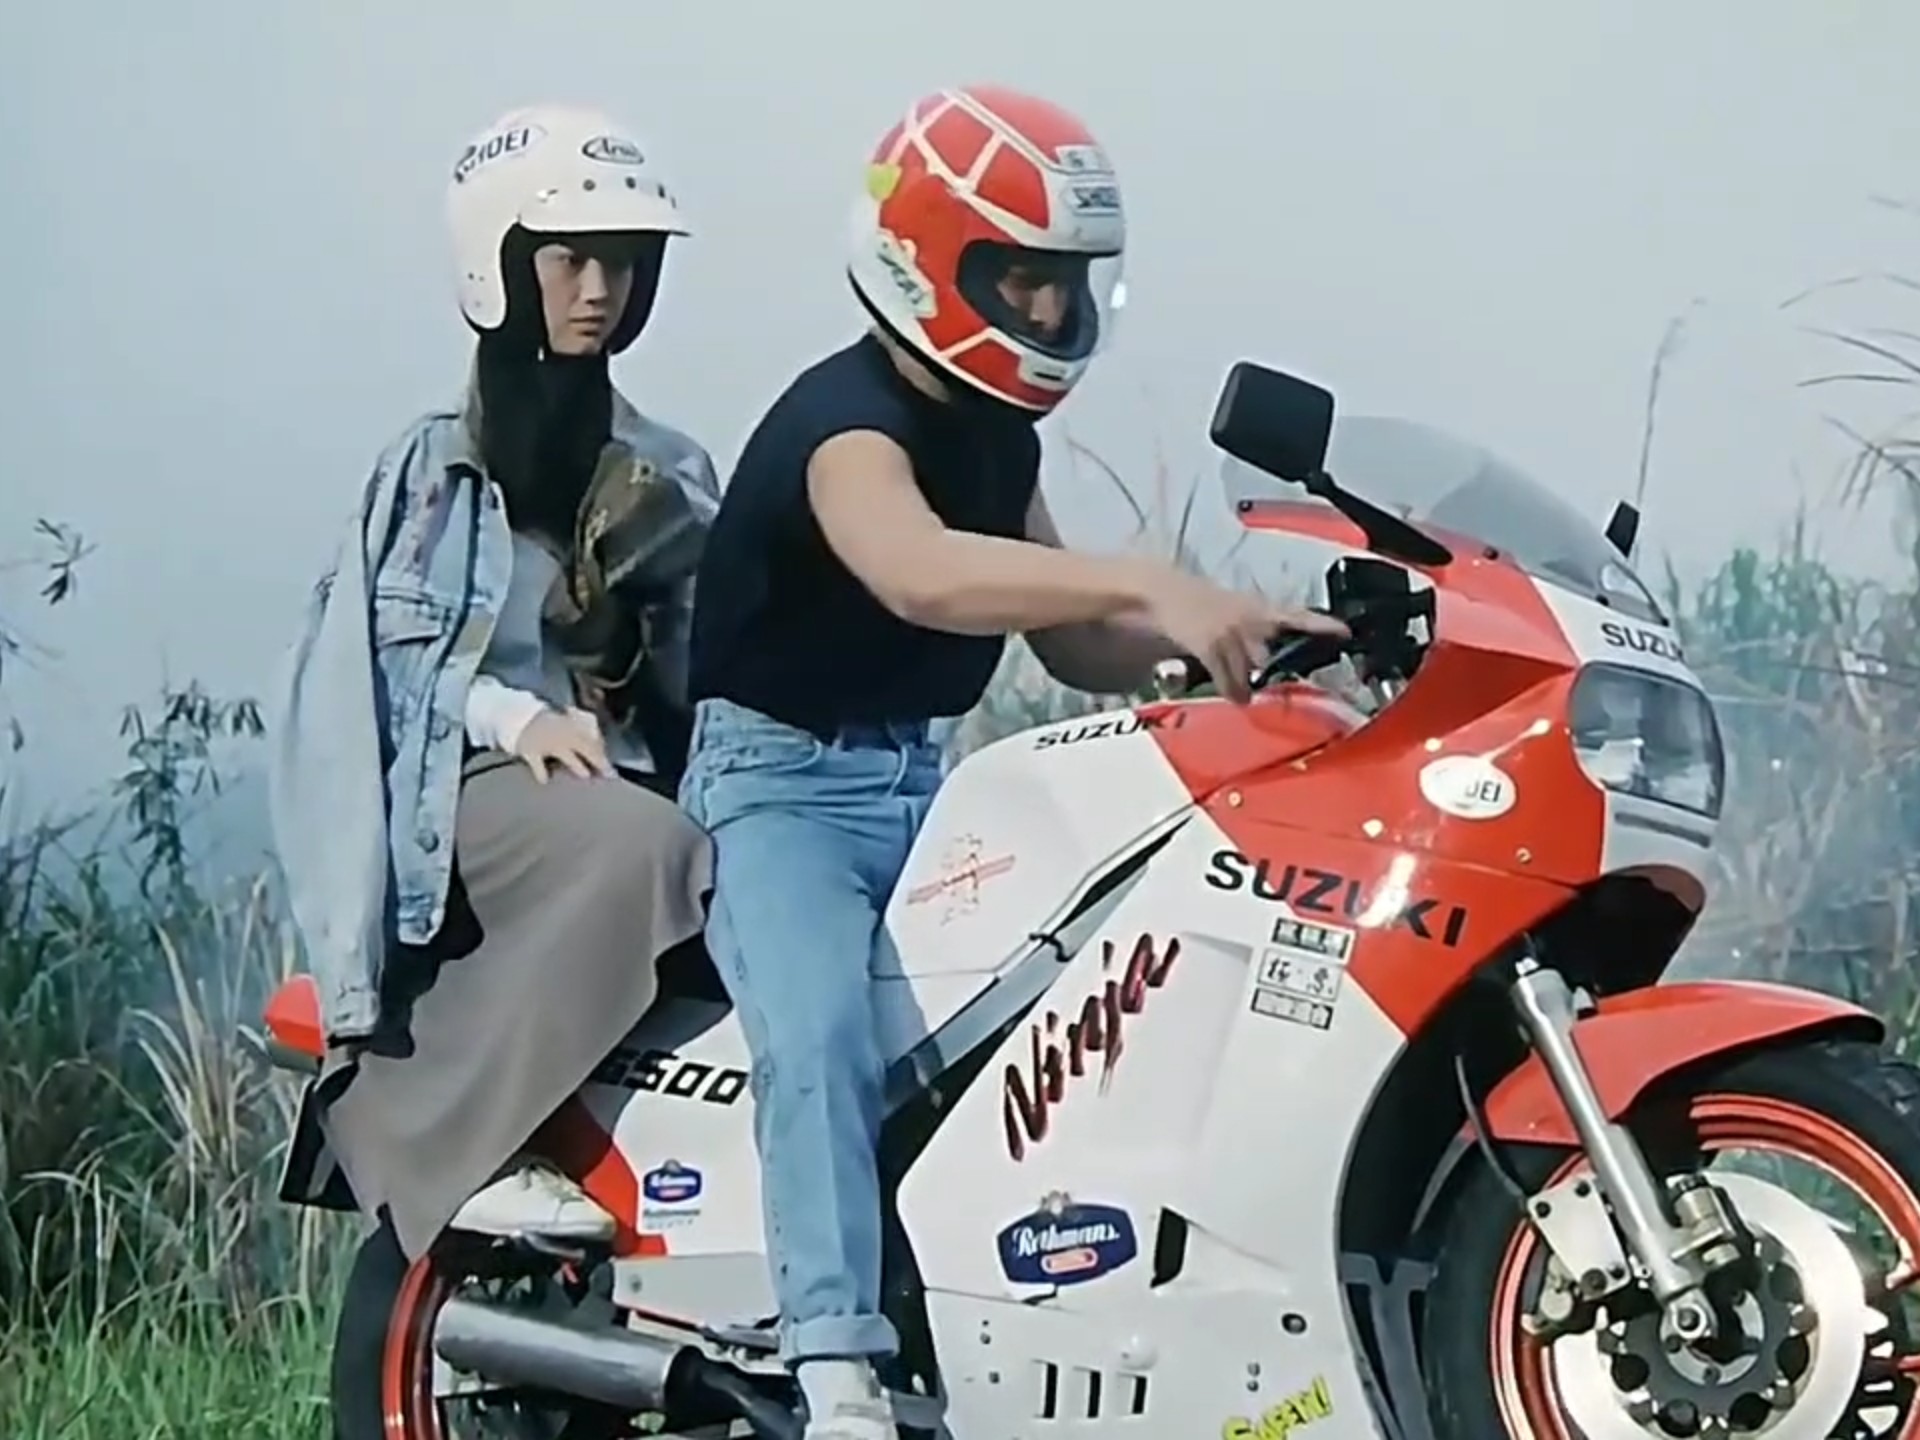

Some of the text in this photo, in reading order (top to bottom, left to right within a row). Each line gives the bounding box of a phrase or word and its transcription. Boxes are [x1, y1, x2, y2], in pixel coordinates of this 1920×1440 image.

[1601, 623, 1684, 662] SUZU
[1034, 711, 1186, 751] SUZUKI
[1003, 932, 1181, 1163] Ninja
